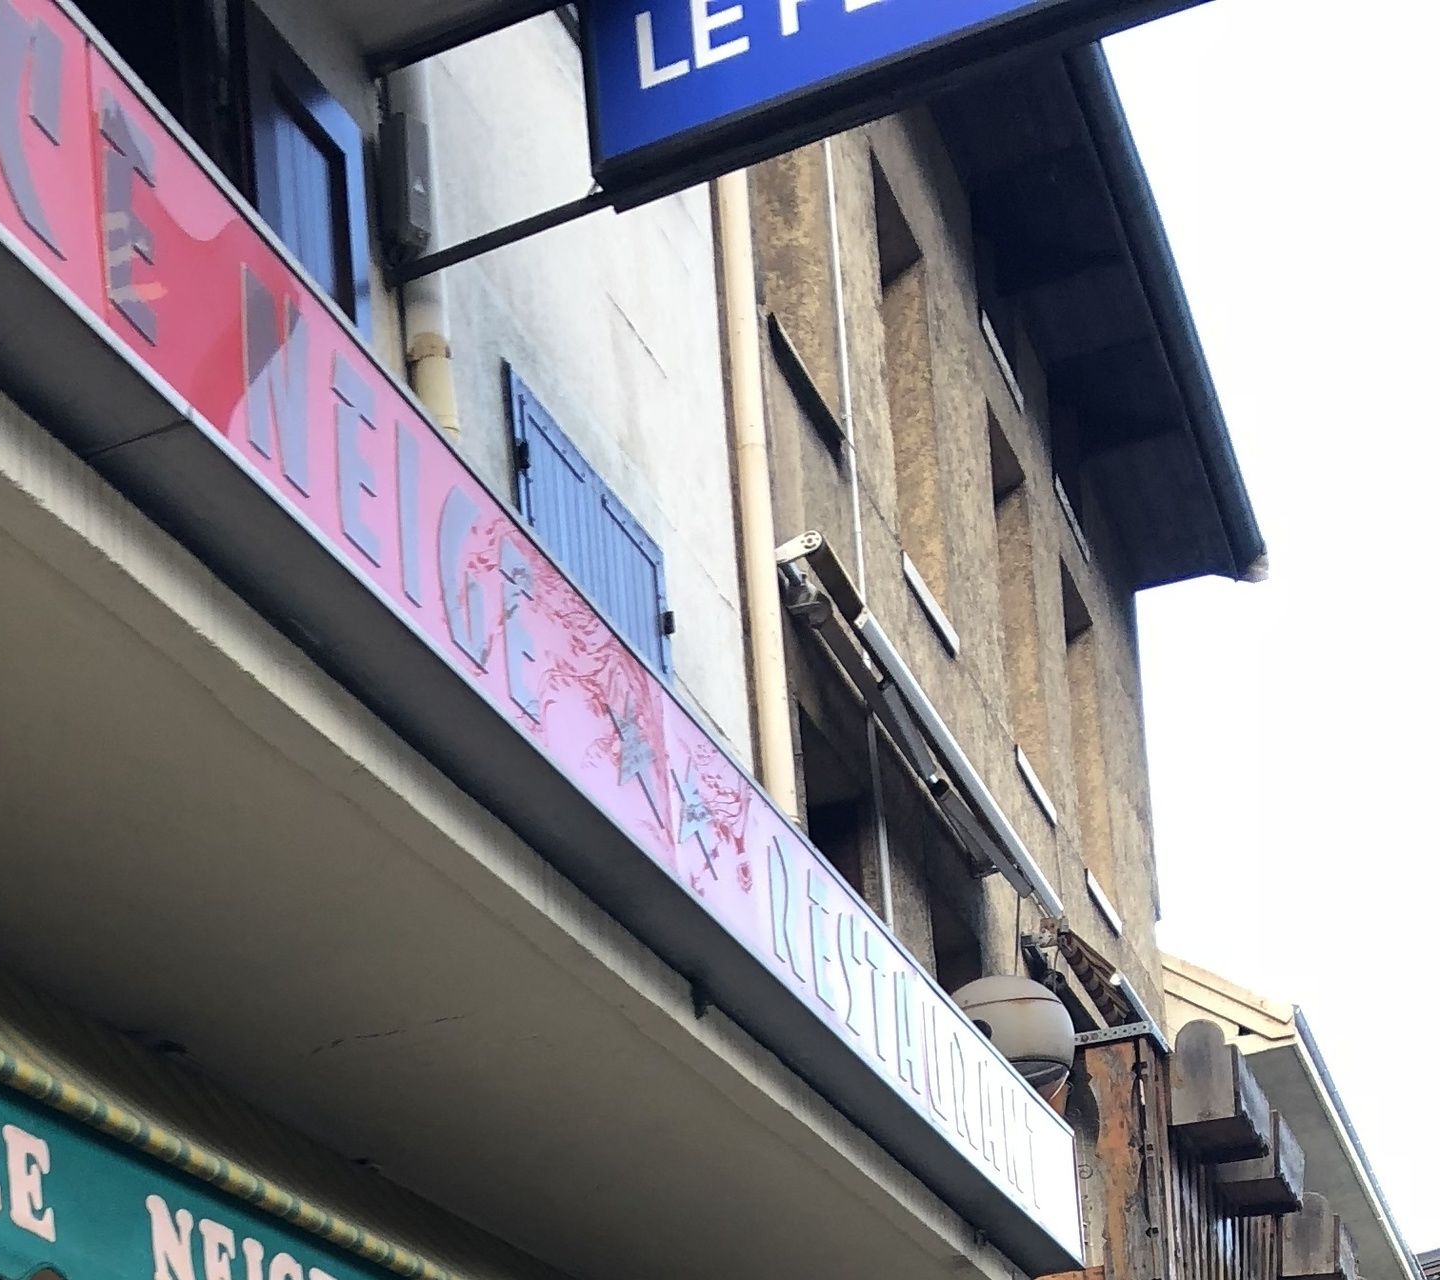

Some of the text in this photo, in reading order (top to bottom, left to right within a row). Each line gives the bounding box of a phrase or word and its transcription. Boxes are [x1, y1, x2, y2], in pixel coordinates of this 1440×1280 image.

[635, 0, 750, 90] LE
[241, 262, 542, 725] NEIGE
[767, 835, 1042, 1211] RESTAURANT
